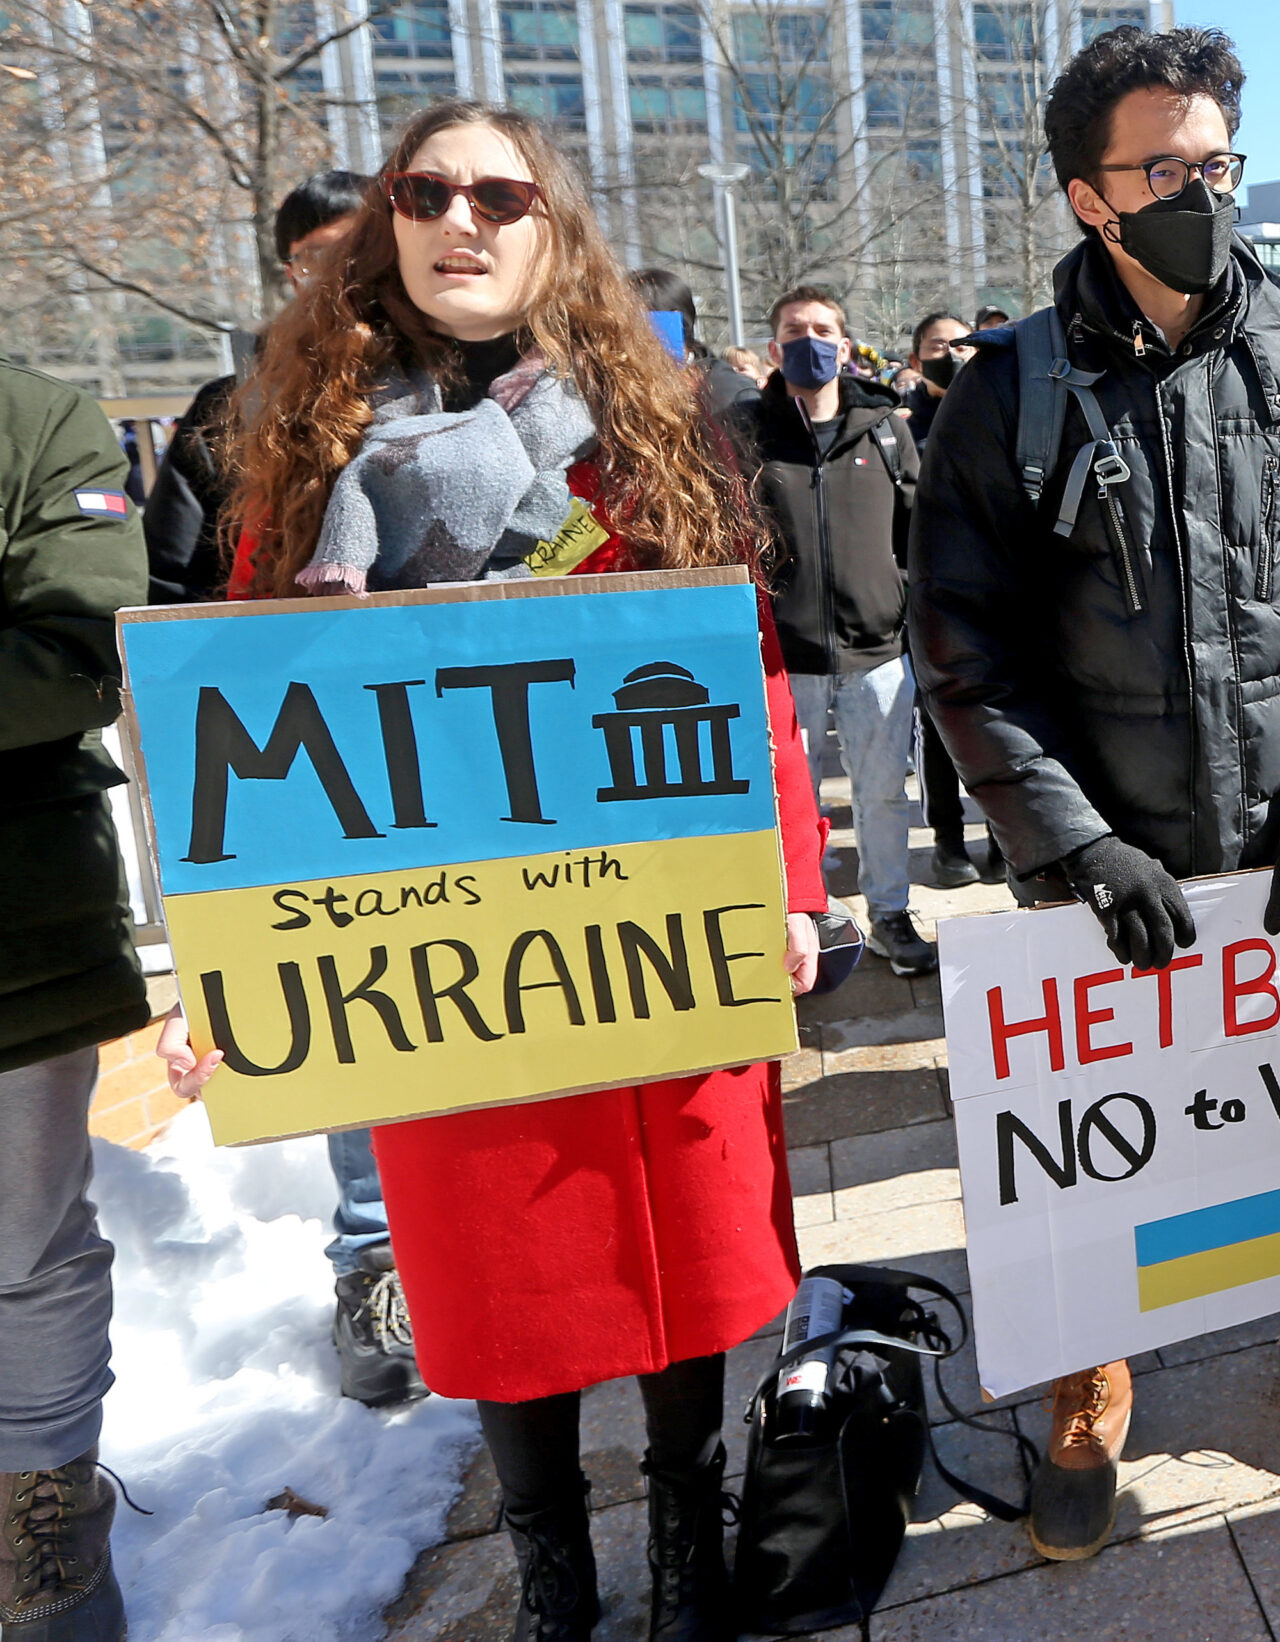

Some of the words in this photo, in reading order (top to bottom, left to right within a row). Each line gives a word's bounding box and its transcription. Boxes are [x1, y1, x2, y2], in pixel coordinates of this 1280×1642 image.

[180, 659, 575, 864] MIT
[523, 850, 628, 891] with
[201, 903, 781, 1077] UKRAINE
[989, 953, 1202, 1080] НЕТ
[996, 1092, 1156, 1205] NO
[1185, 1089, 1245, 1130] to
